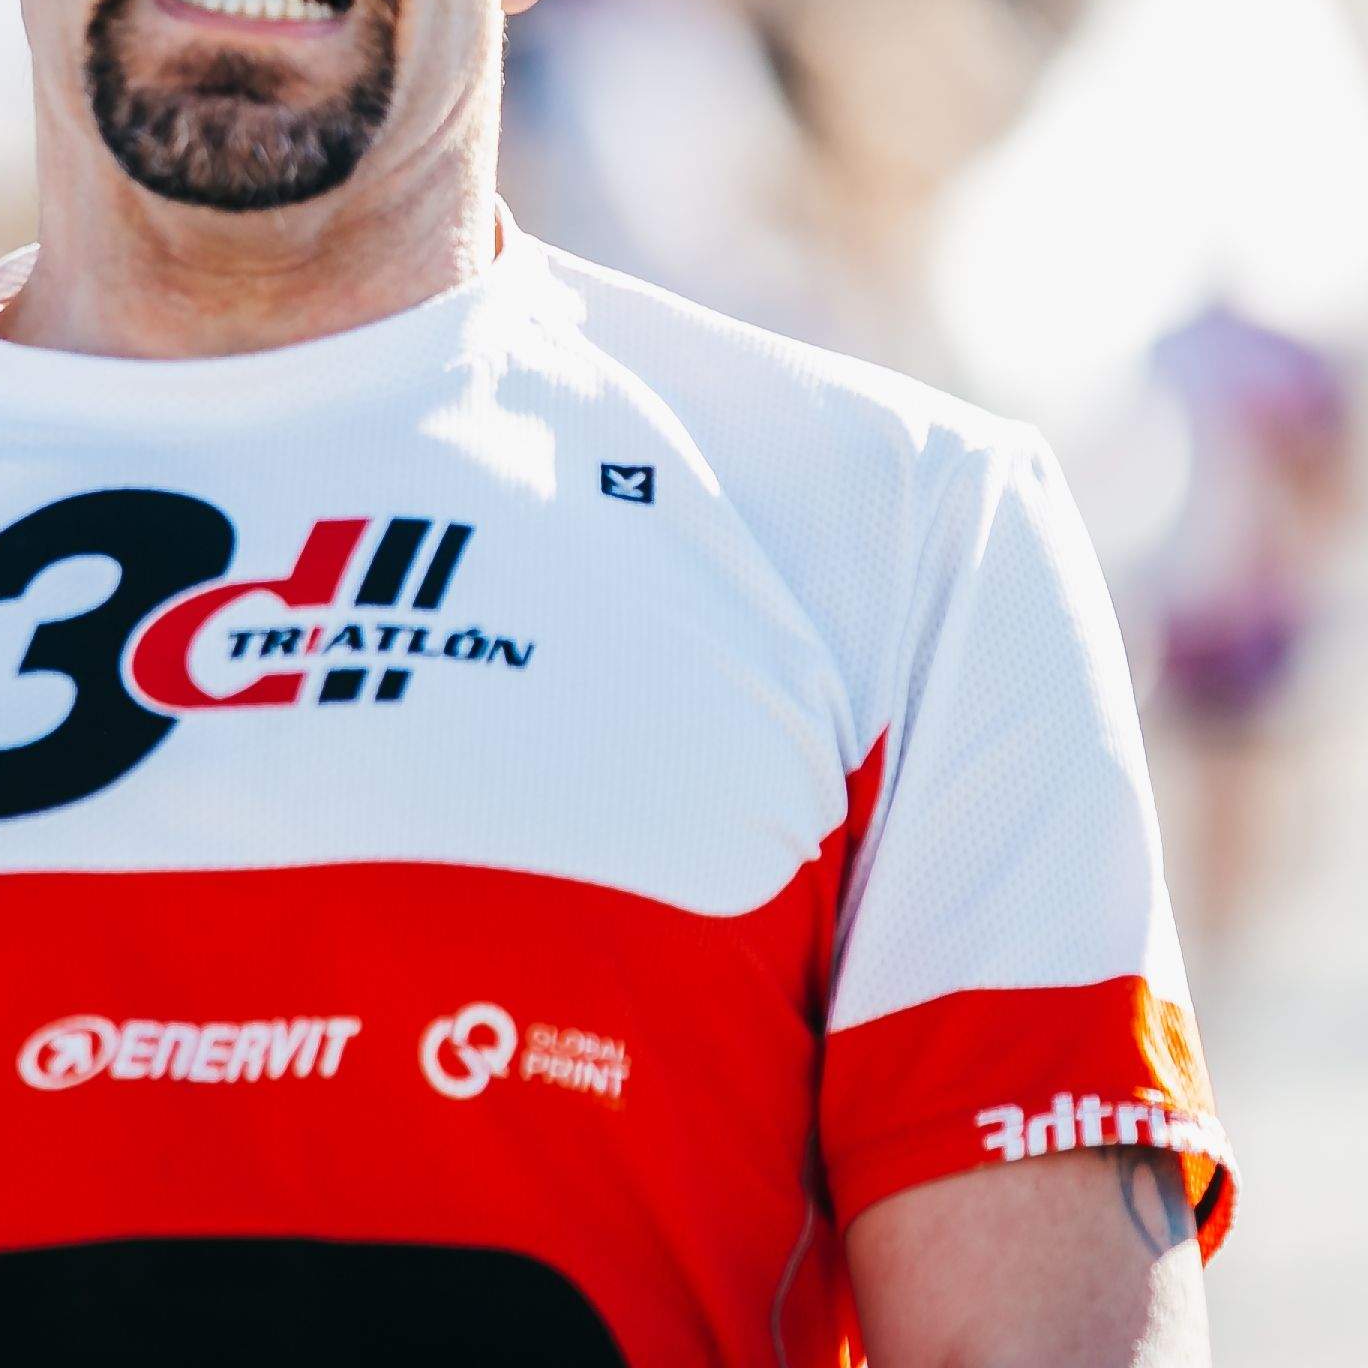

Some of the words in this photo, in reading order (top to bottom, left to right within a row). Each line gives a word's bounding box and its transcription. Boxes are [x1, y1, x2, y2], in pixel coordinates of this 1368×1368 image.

[228, 623, 536, 668] TRIATLÓN
[109, 1015, 363, 1084] ENERVIT
[519, 1051, 630, 1099] PRINT
